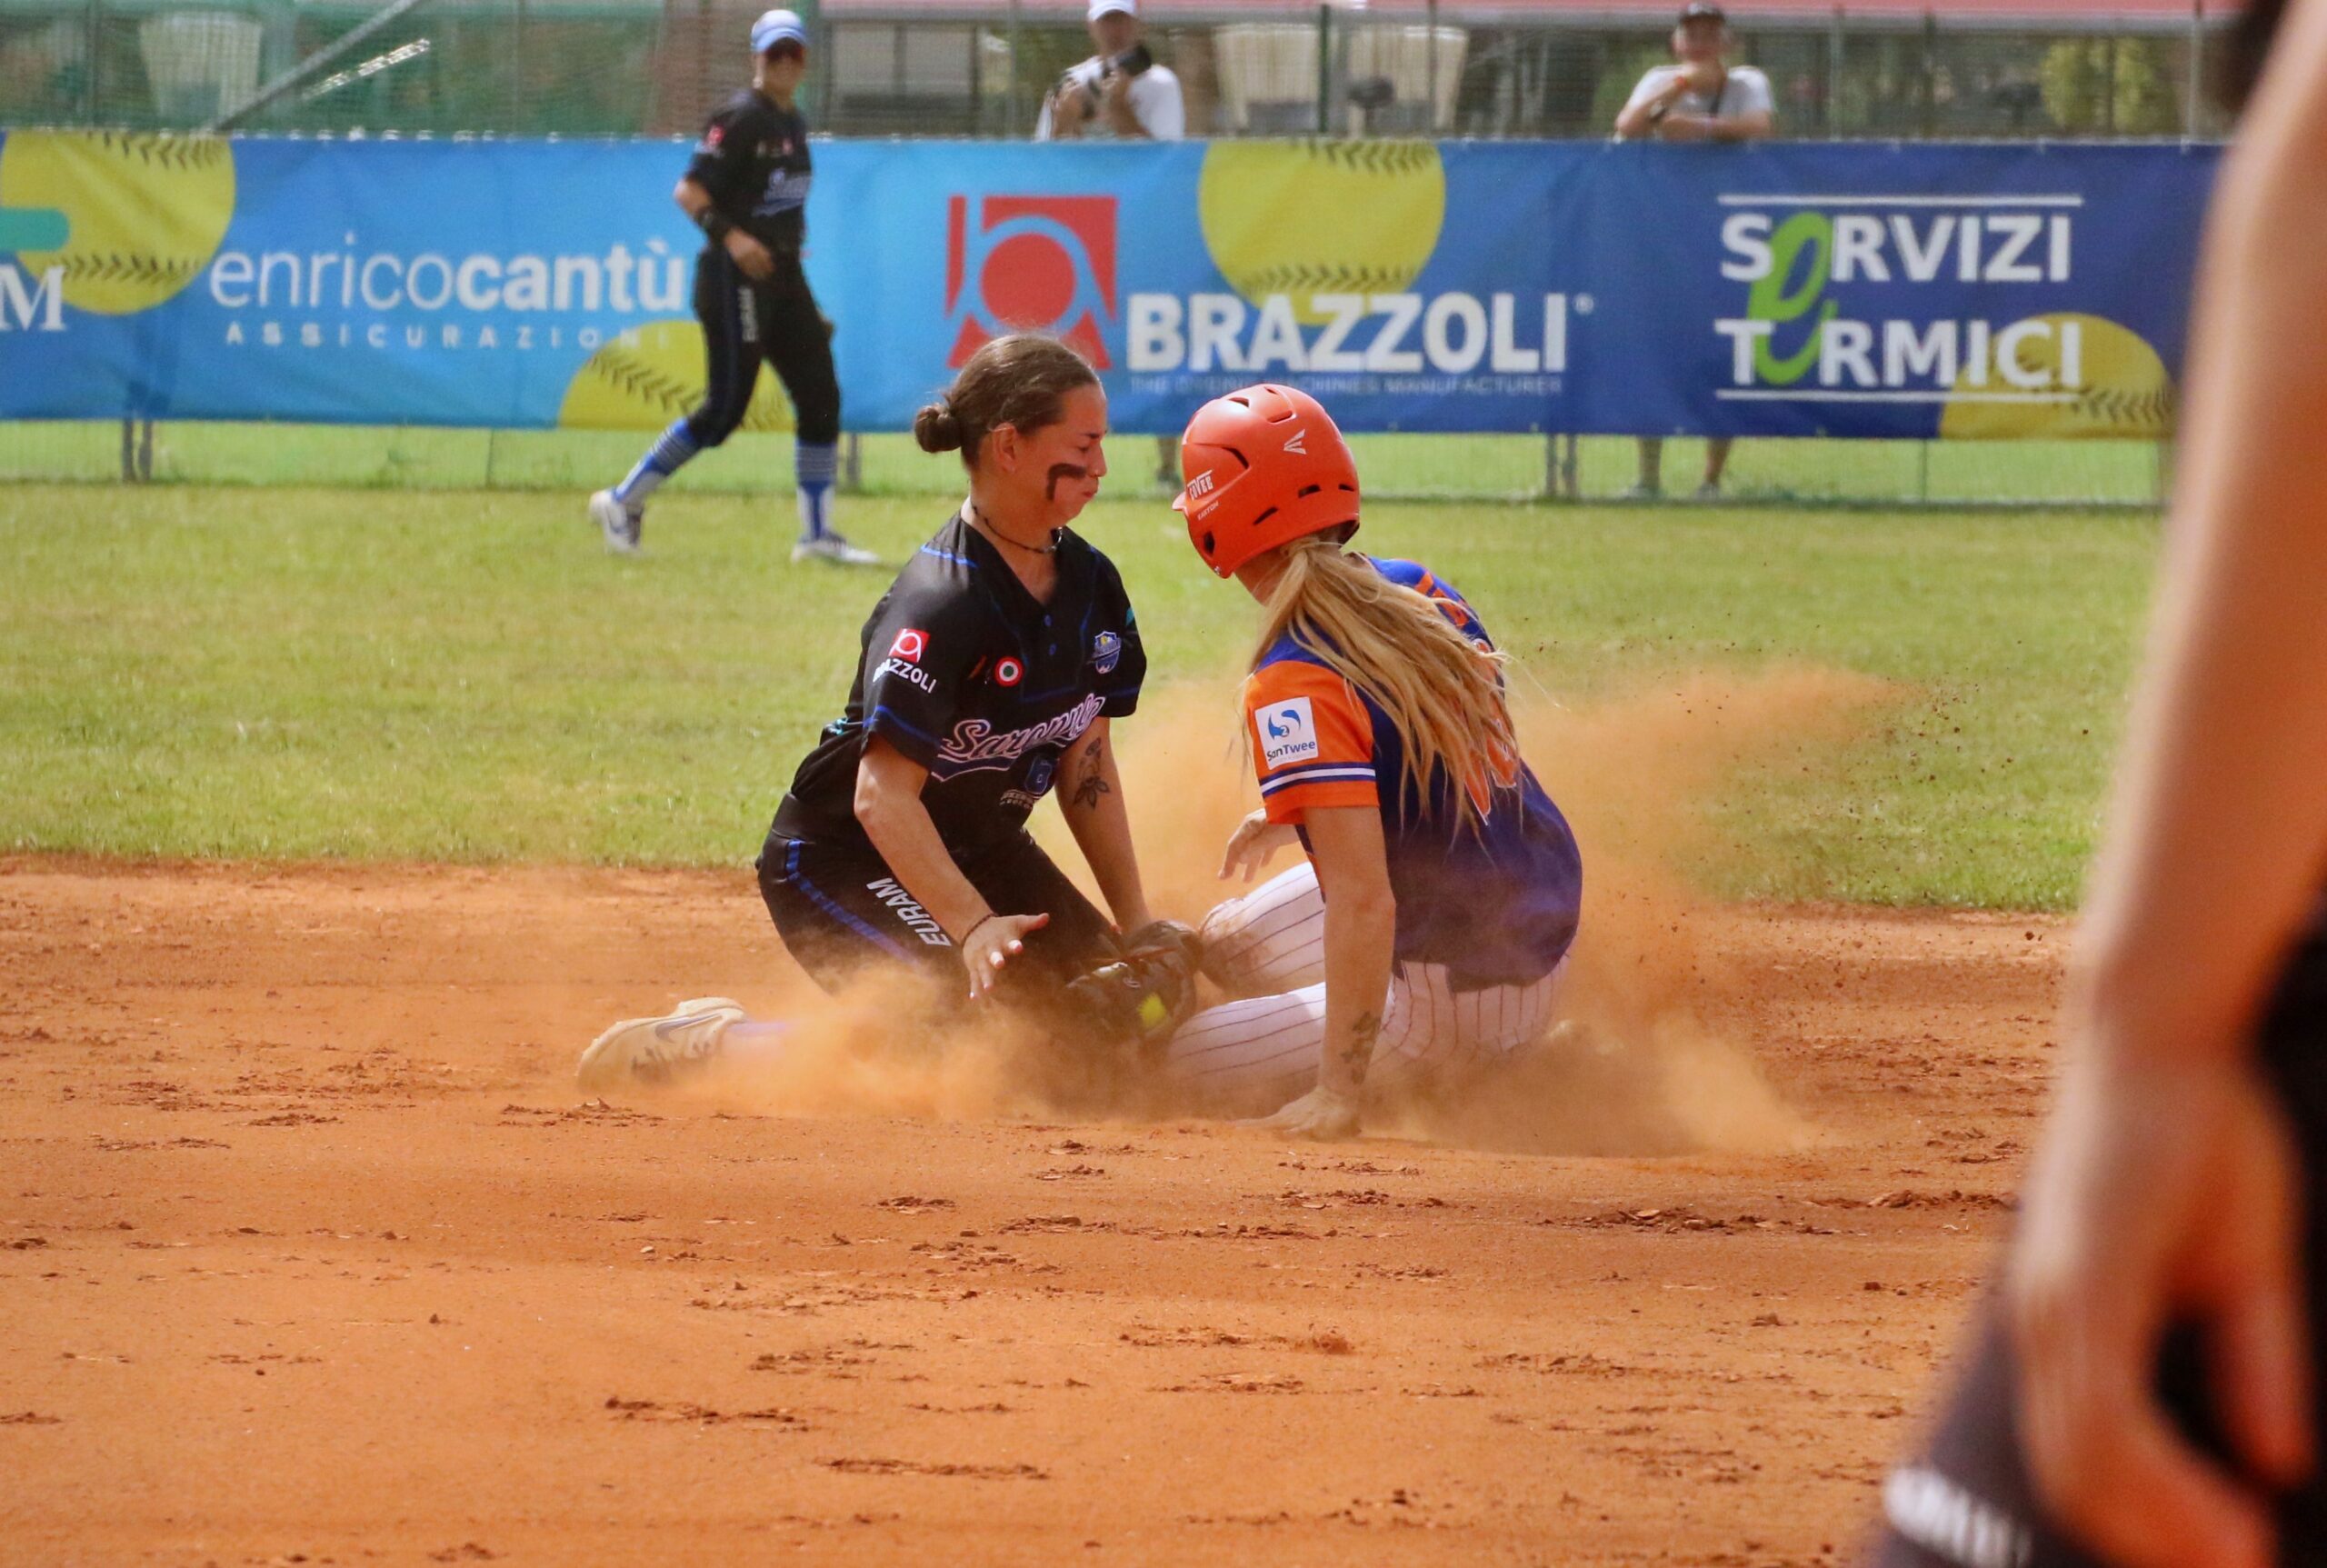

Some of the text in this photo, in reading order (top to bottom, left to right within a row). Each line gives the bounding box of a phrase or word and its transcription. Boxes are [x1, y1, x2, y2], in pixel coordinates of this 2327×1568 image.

[210, 231, 685, 311] enricocantù
[226, 321, 669, 349] ASSICURAZIONI
[866, 877, 952, 946] EURAM
